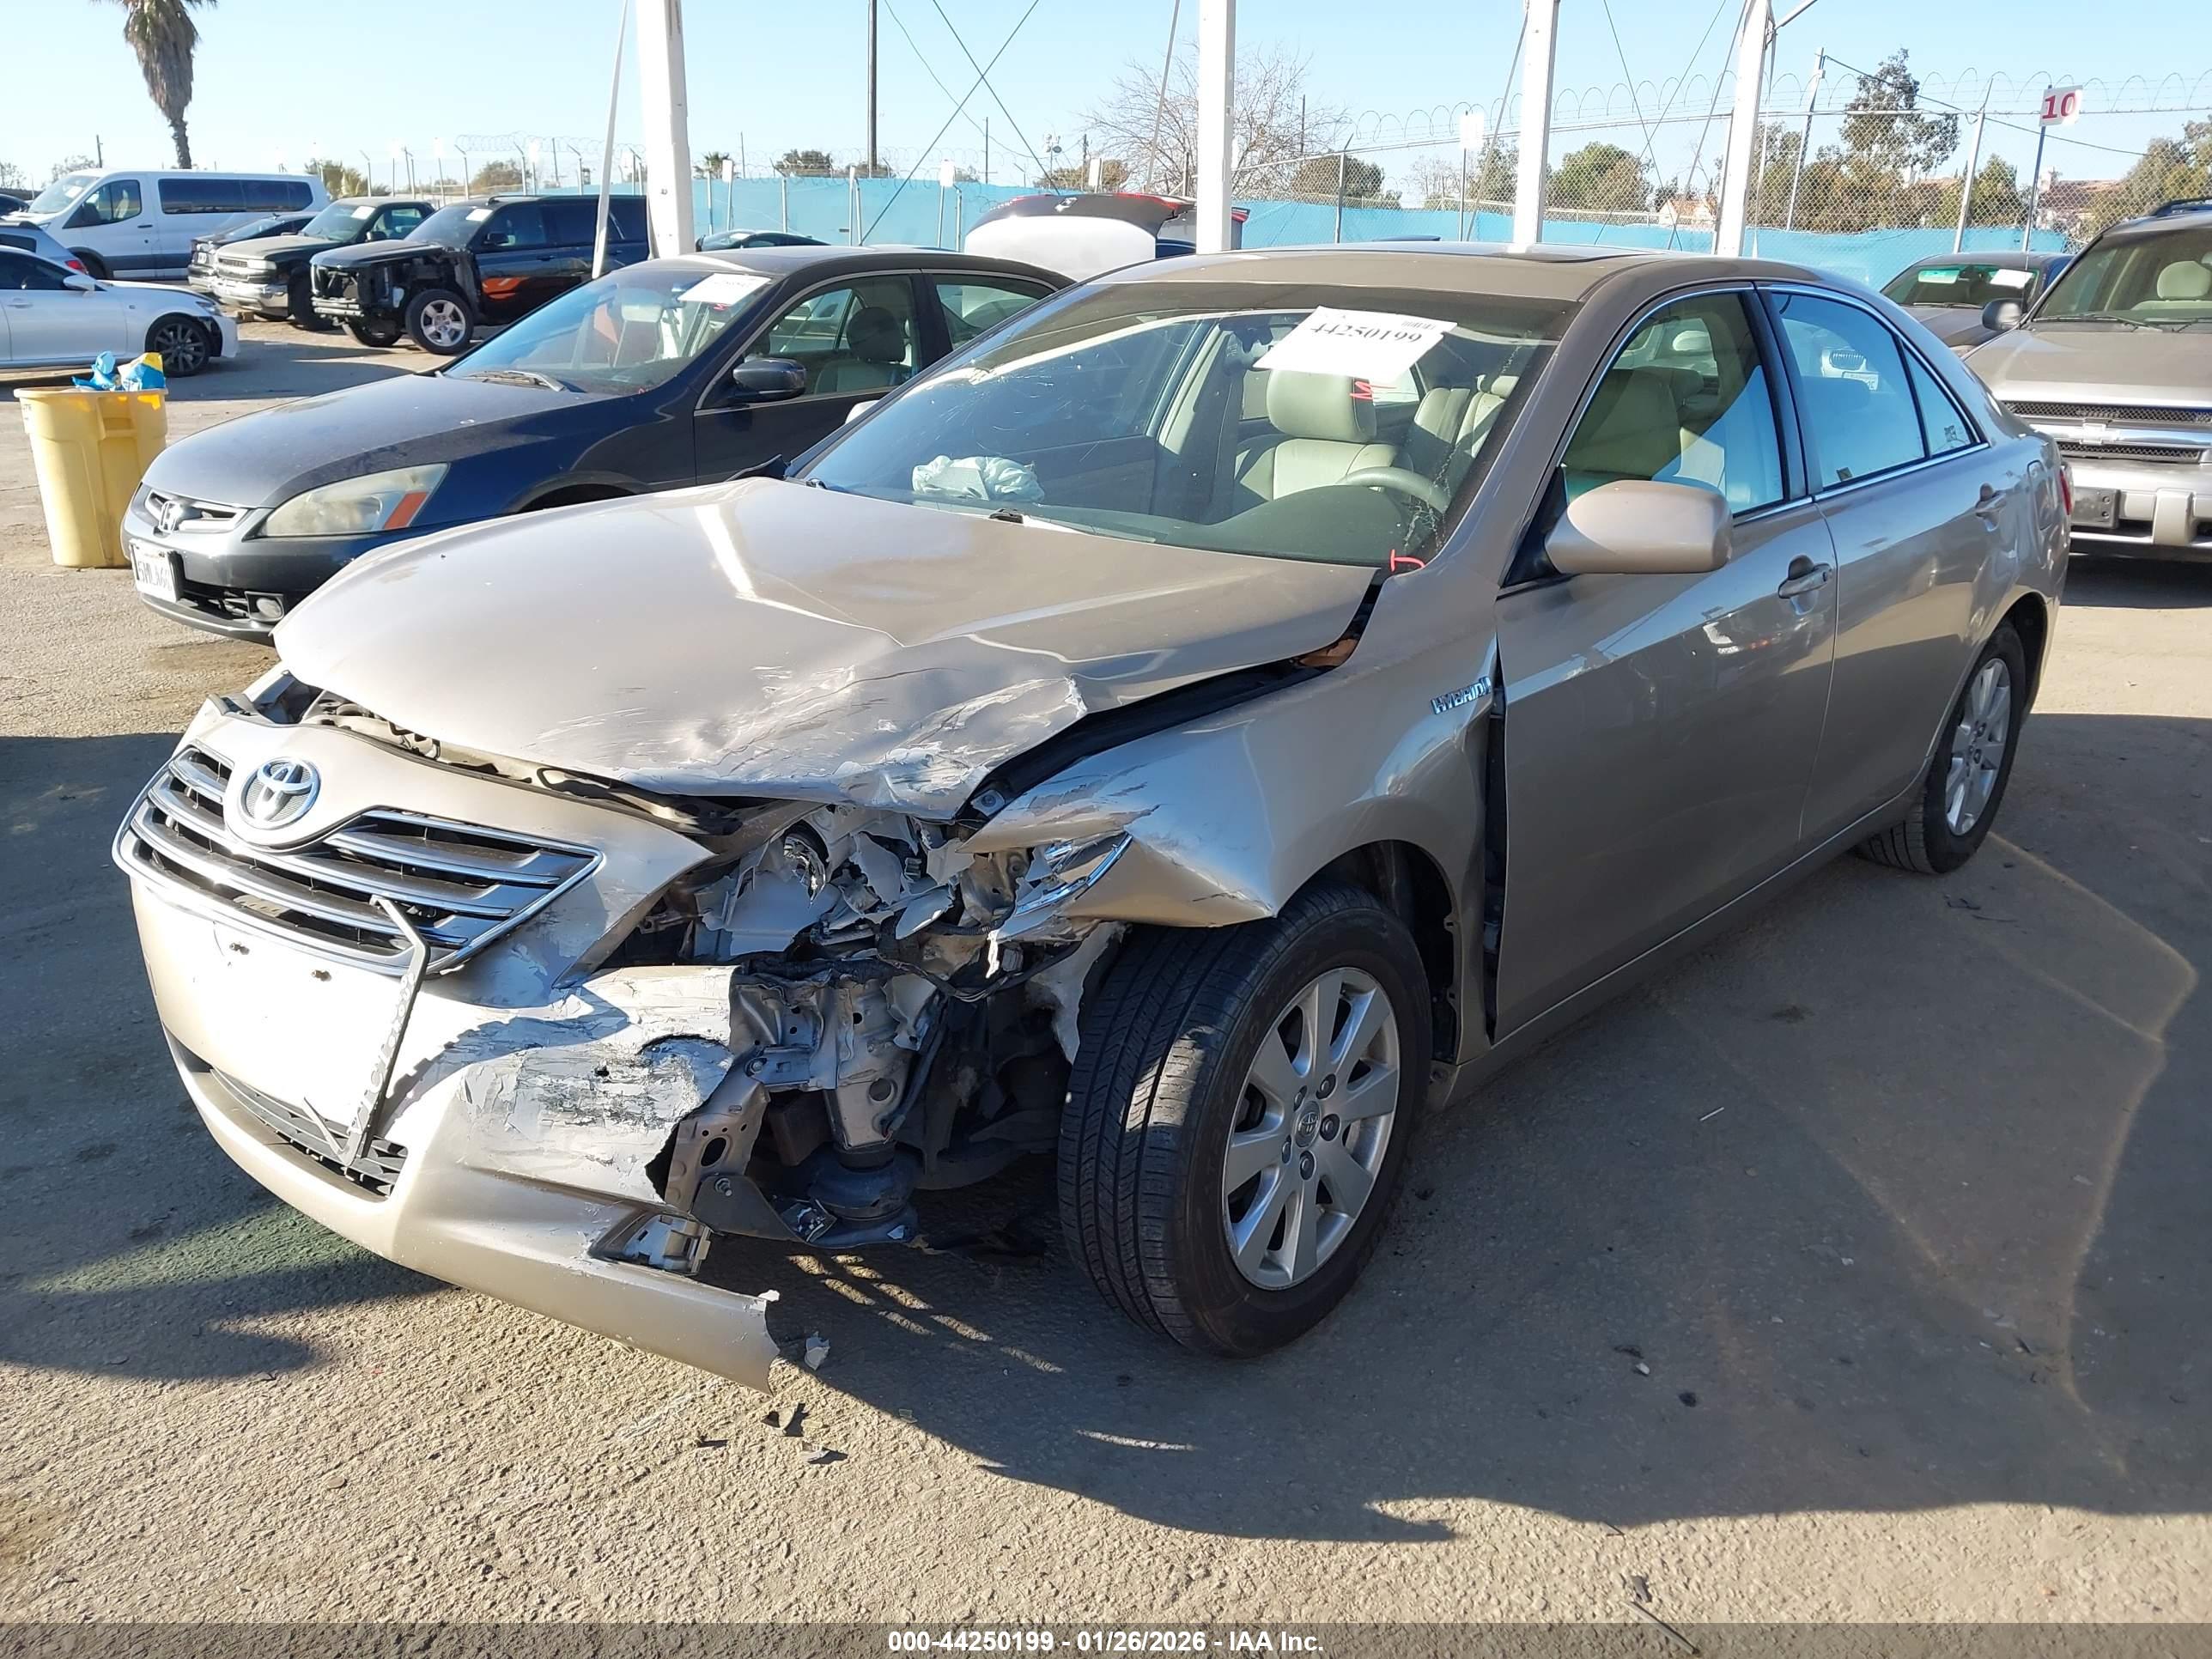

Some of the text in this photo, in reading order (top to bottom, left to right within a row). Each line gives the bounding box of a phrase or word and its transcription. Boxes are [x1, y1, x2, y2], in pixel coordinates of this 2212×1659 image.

[2042, 92, 2076, 119] 10
[1310, 321, 1423, 343] 44250199
[1431, 676, 1492, 714] HYBRID
